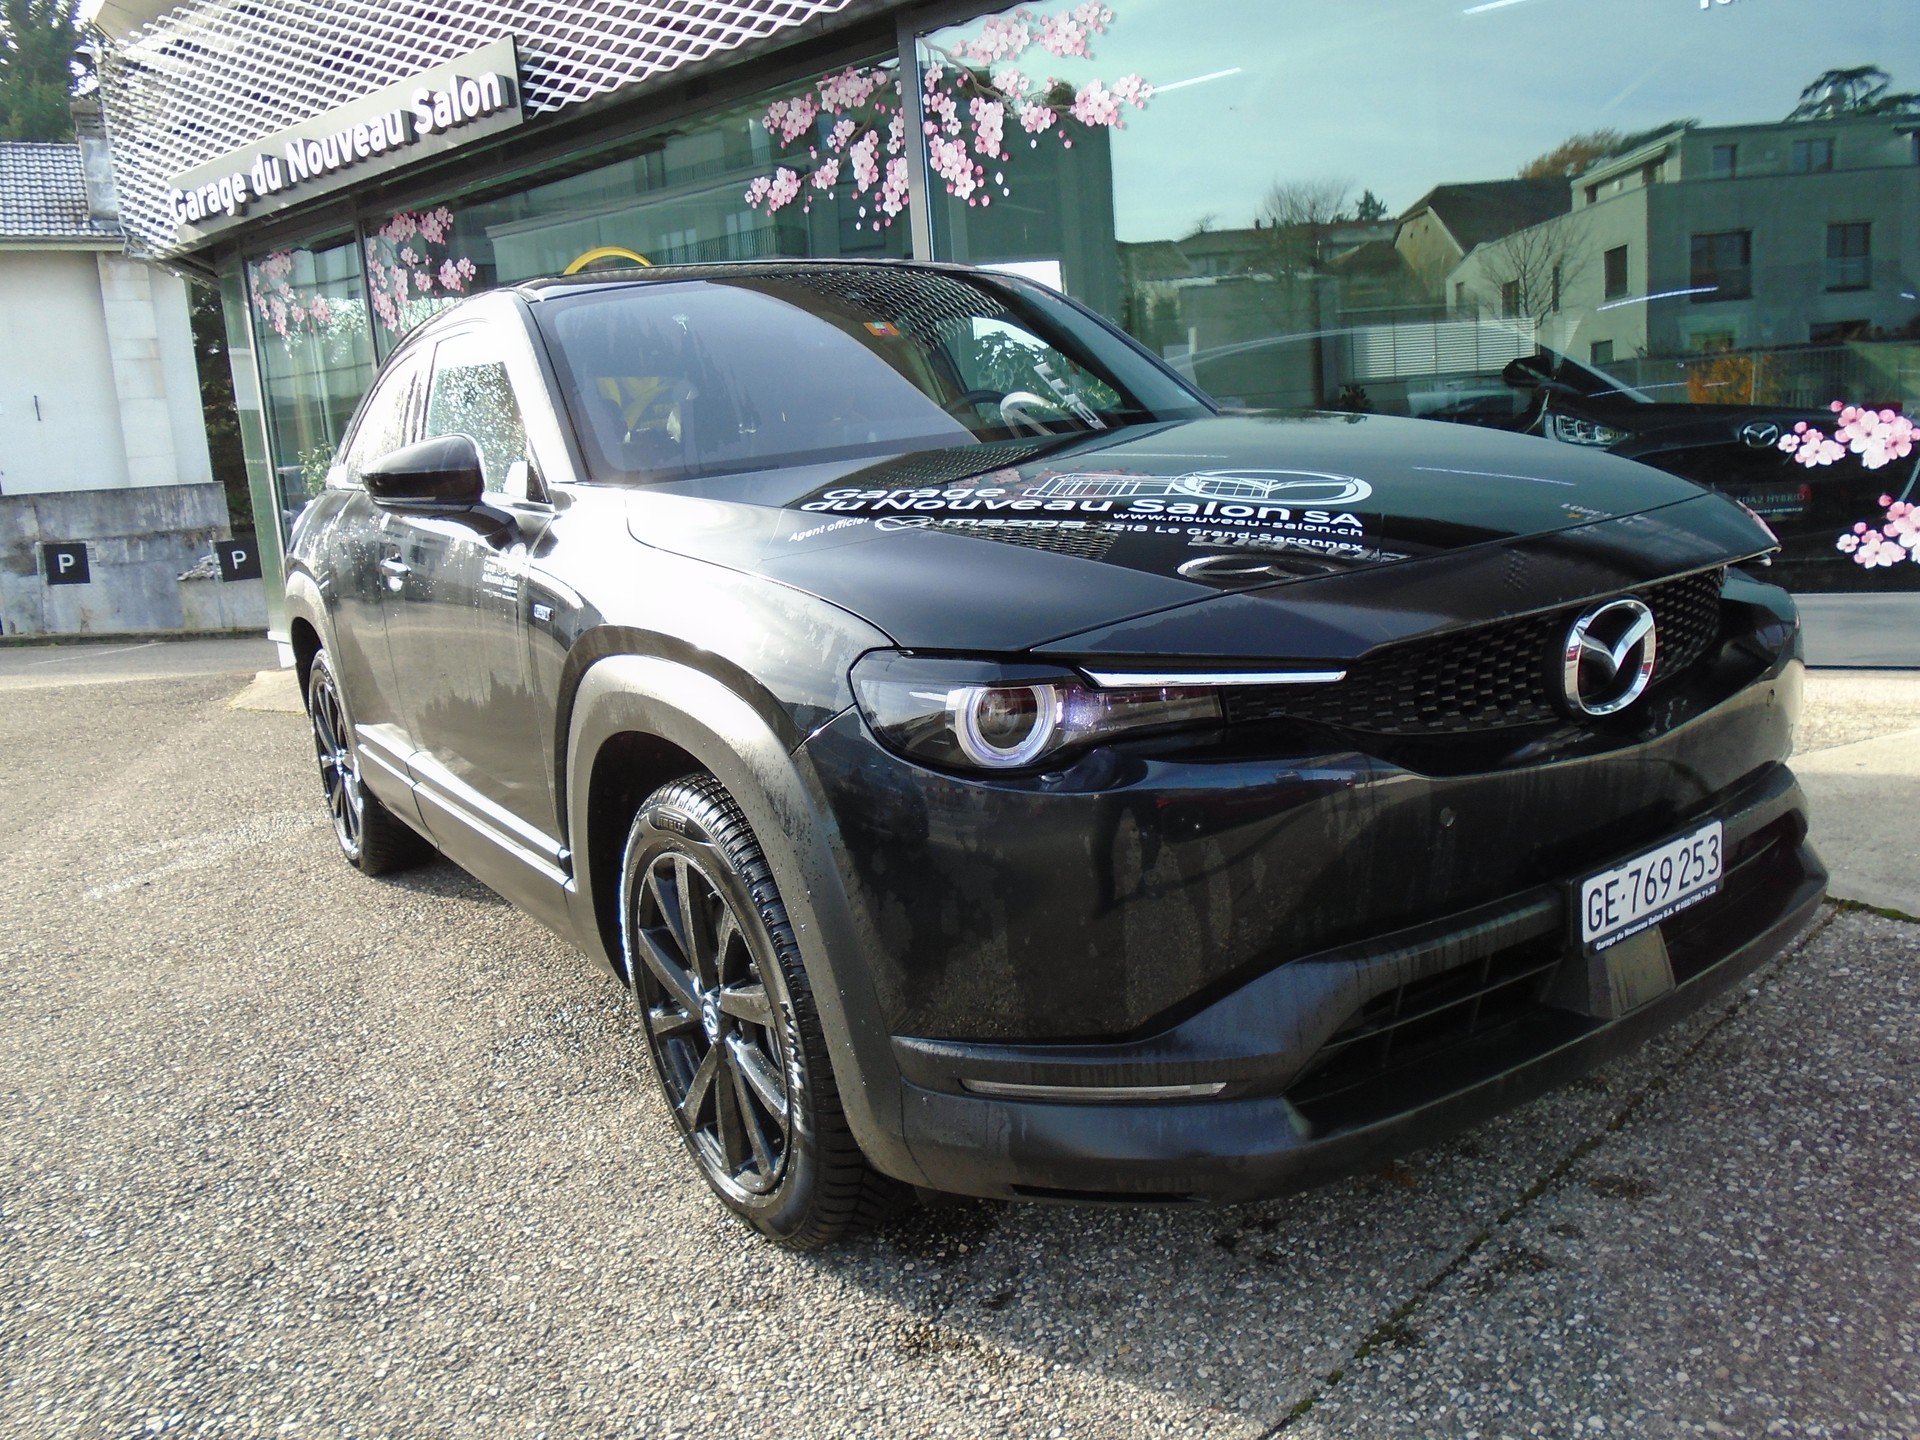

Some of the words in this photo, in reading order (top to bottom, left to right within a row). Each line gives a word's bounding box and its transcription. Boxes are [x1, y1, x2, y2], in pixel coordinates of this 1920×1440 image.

[171, 172, 247, 225] Garage
[251, 153, 283, 196] du
[285, 109, 405, 183] Nouveau
[411, 71, 502, 134] Salon
[823, 488, 1006, 500] Garage
[800, 499, 866, 511] du
[870, 498, 1114, 512] Nouveau
[1127, 498, 1291, 521] Salon
[1302, 510, 1363, 528] SA
[788, 523, 825, 542] Agent
[1112, 513, 1363, 537] www.nouveau-salon.ch
[1154, 525, 1179, 534] Le
[1185, 526, 1363, 551] Grand-Saconnex
[58, 553, 75, 574] P
[231, 550, 247, 569] P
